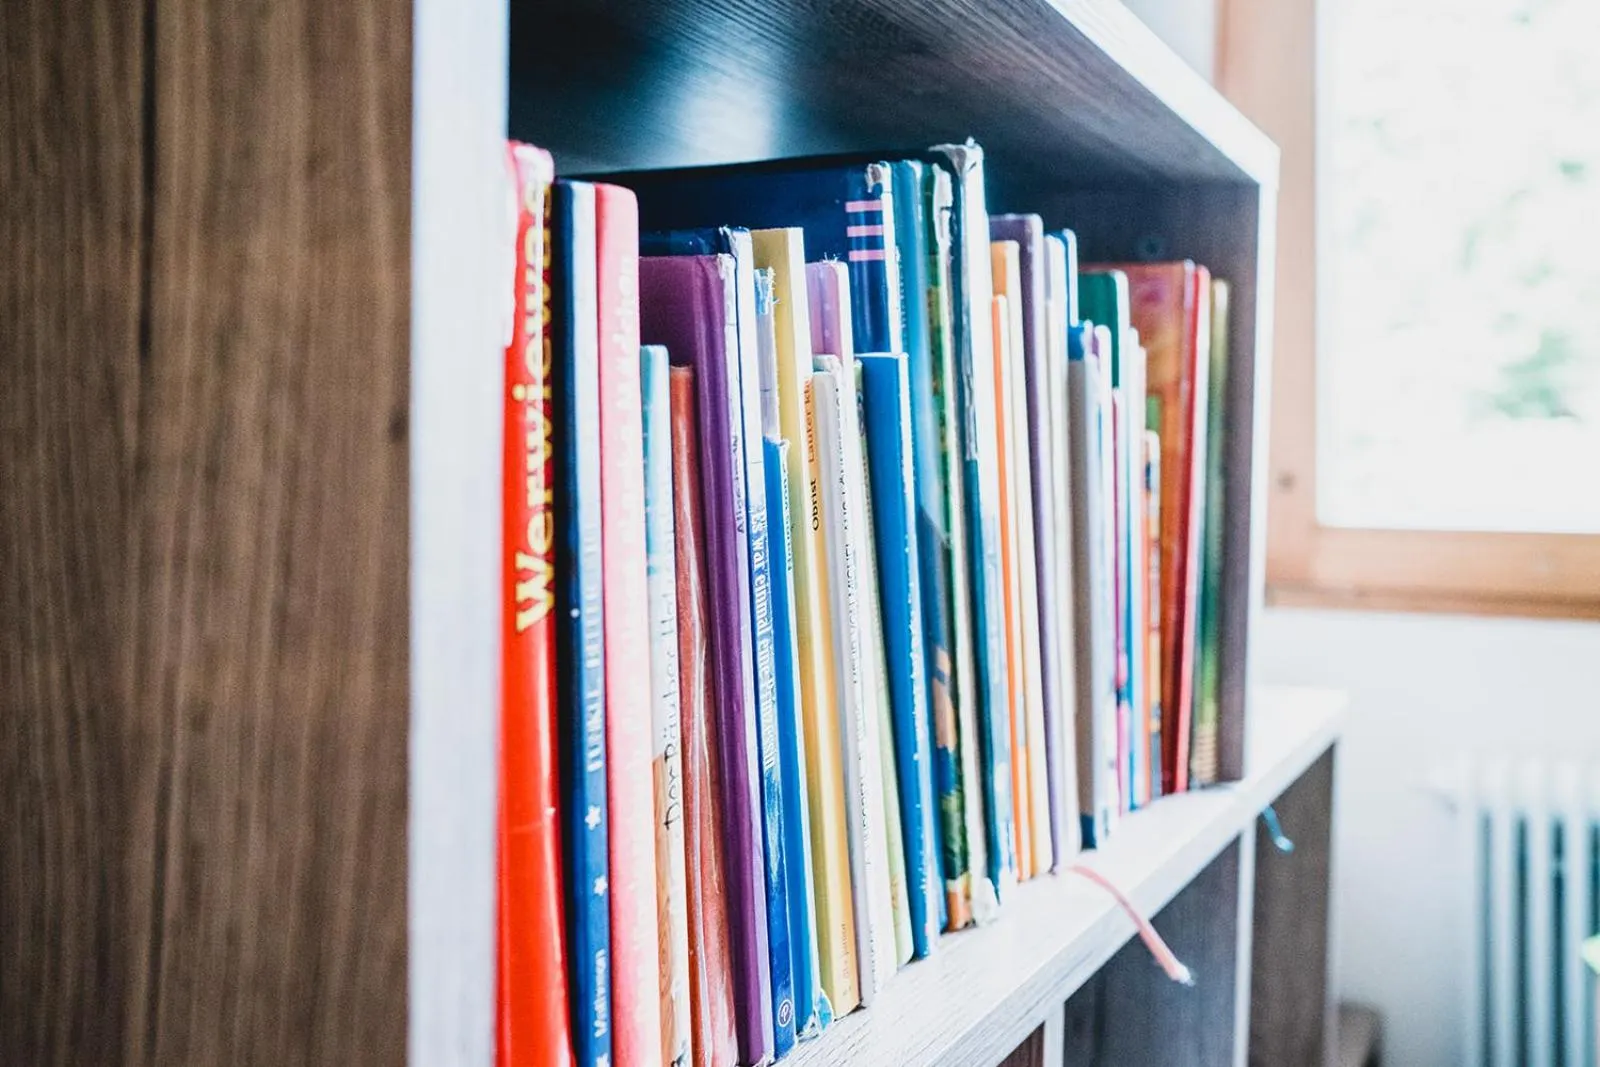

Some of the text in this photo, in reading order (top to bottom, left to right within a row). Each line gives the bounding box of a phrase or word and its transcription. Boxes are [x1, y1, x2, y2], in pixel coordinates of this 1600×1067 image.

[810, 477, 820, 531] Obrist
[752, 538, 769, 568] war
[754, 573, 773, 634] einmal
